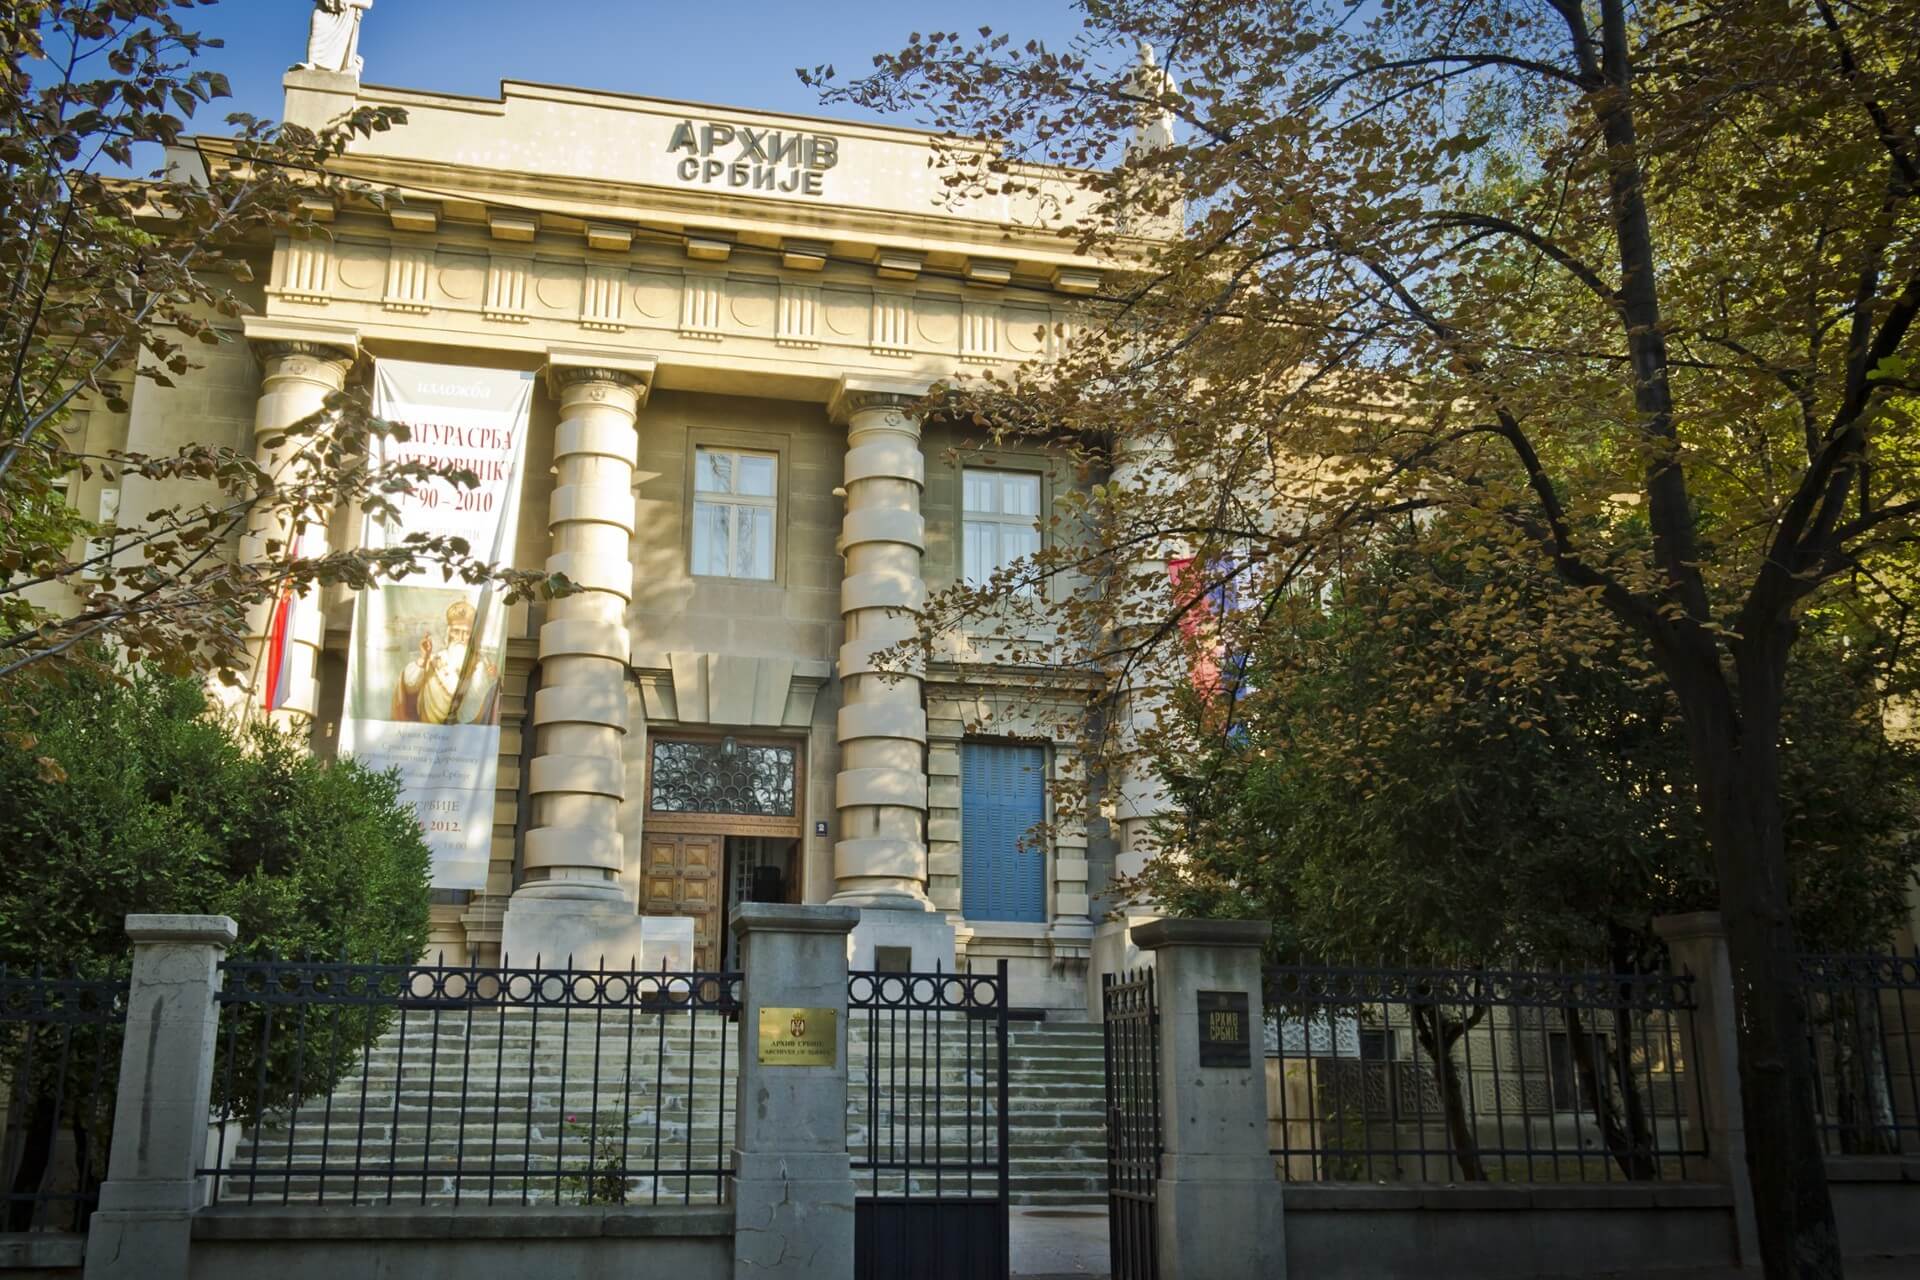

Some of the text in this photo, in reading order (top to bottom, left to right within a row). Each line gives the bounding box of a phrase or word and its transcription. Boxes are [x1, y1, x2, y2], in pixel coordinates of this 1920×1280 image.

[666, 119, 839, 171] АРХИВ
[677, 157, 824, 196] СРБИЈЕ
[455, 490, 493, 513] 2010
